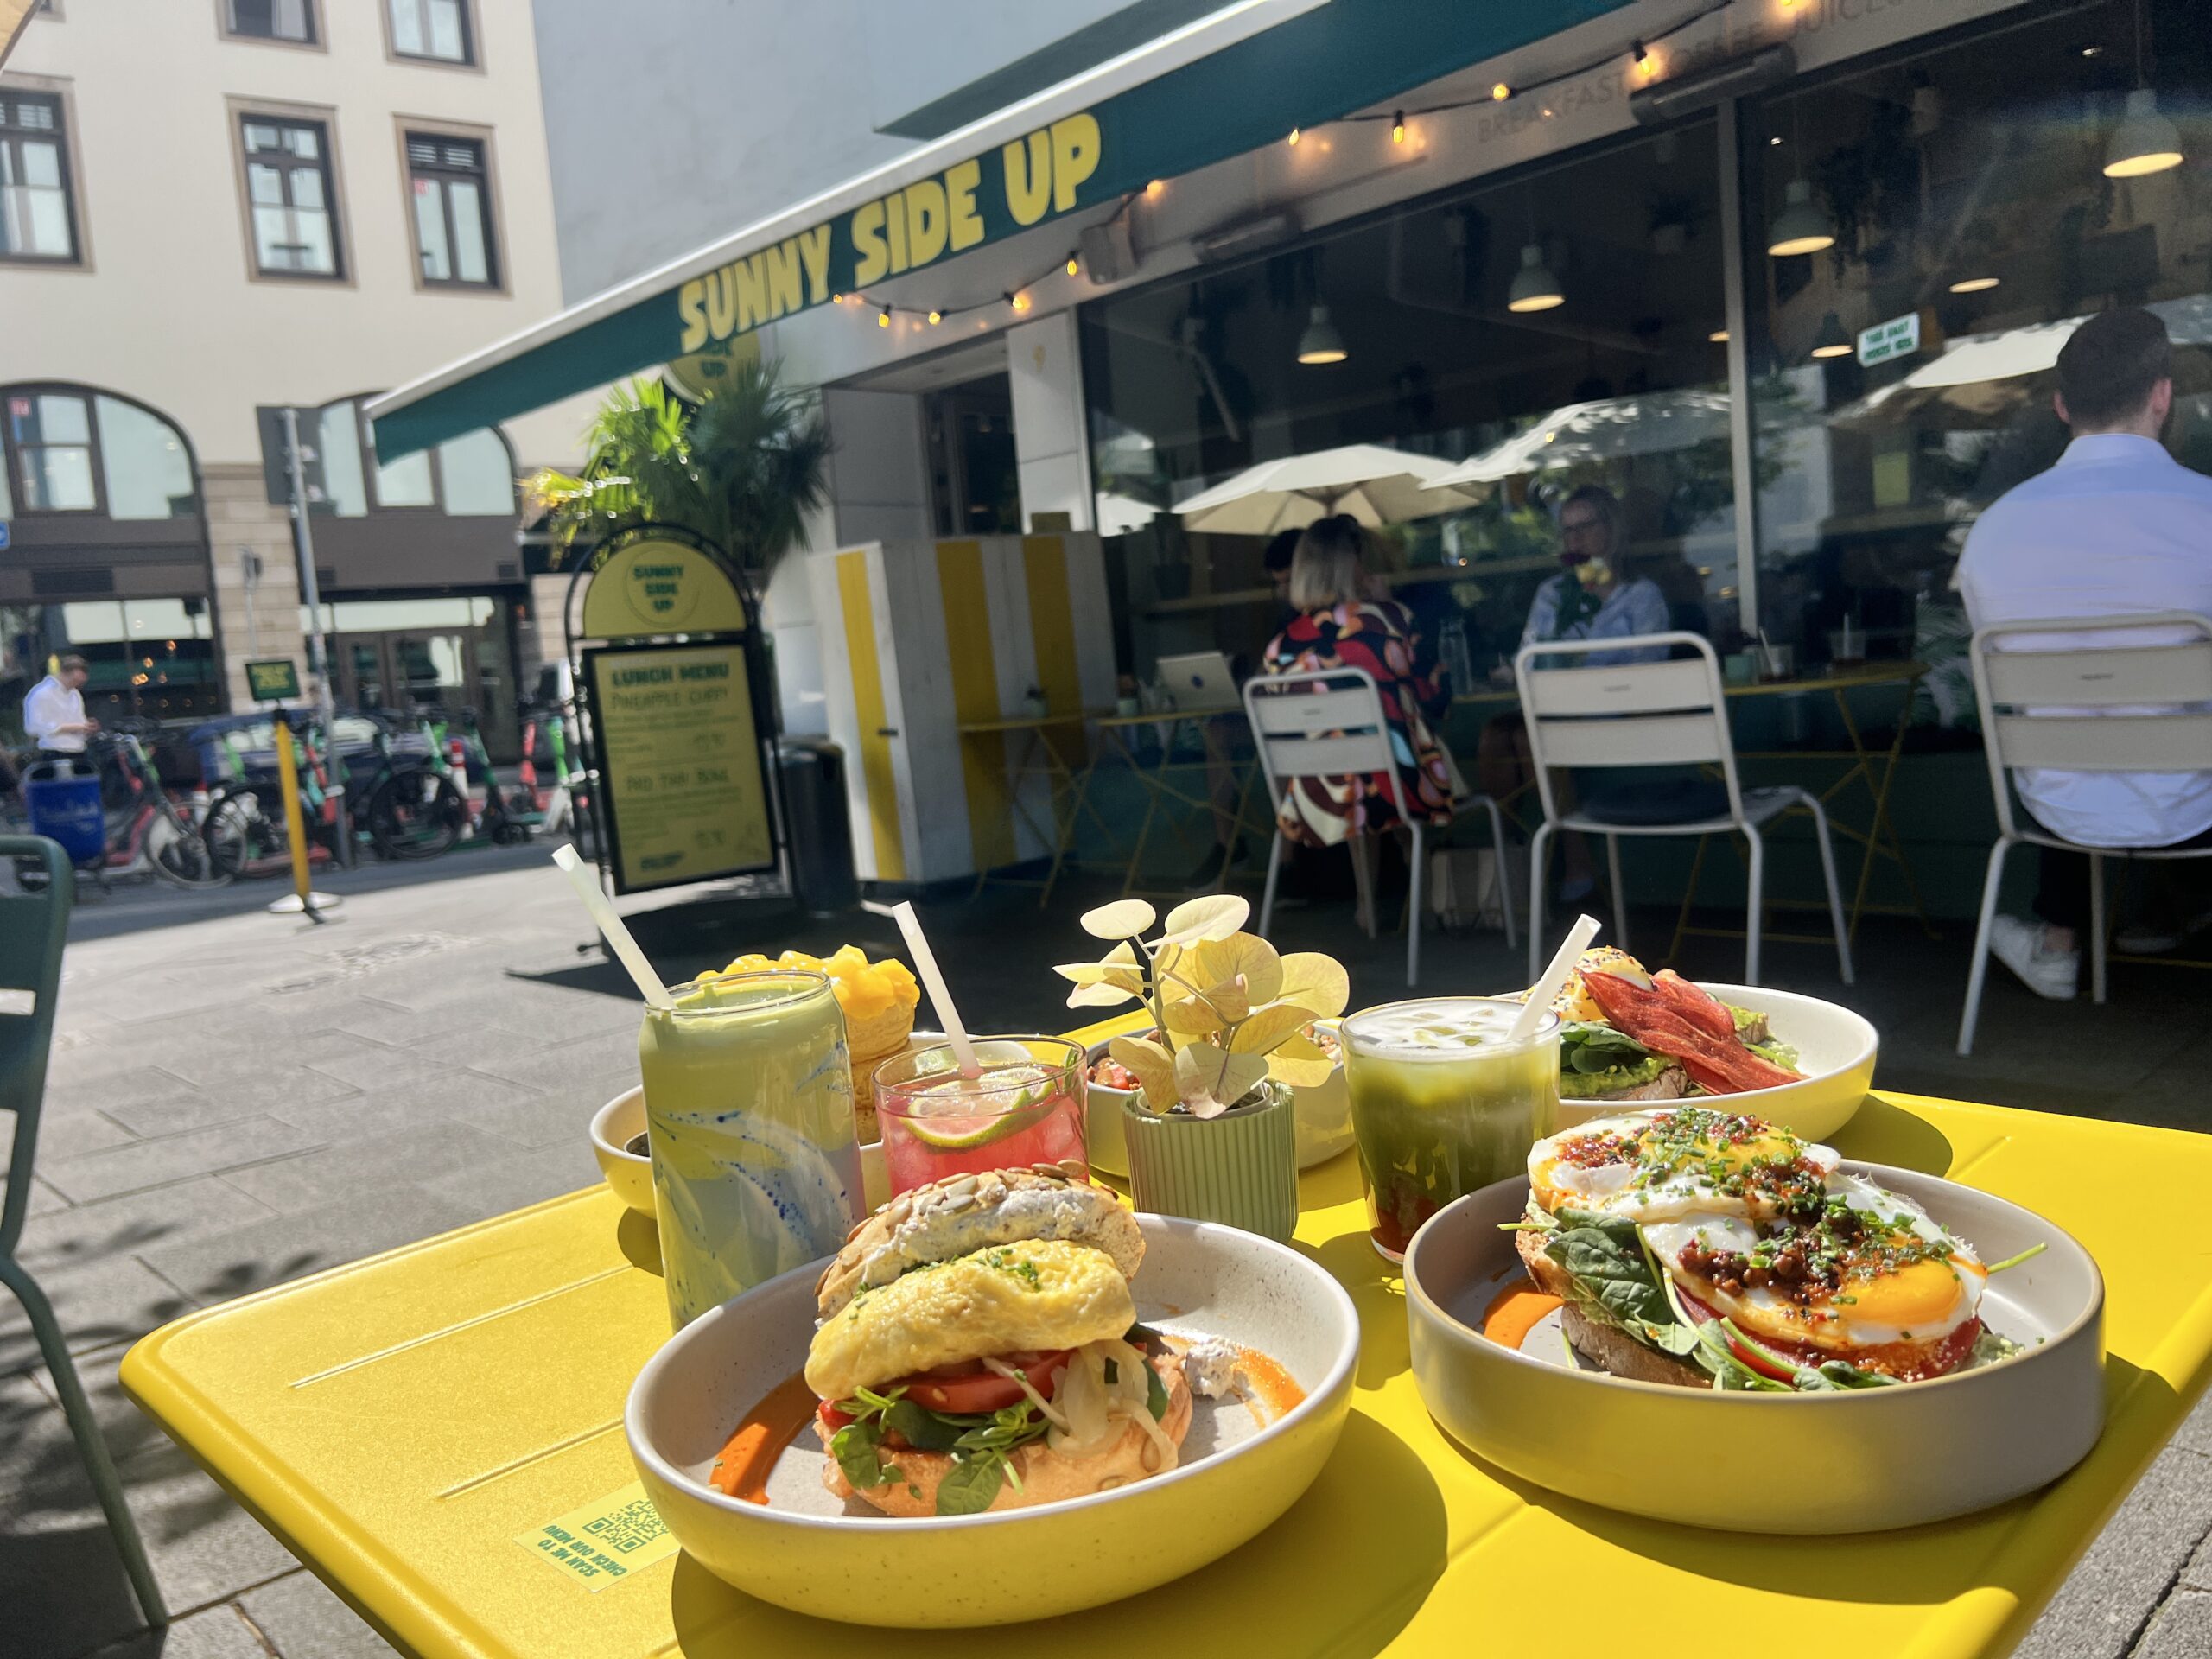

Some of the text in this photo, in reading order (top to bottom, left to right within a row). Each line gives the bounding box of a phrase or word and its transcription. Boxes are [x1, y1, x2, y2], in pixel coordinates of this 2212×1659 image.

[679, 113, 1102, 353] SUNNY SIDE UP
[634, 564, 684, 581] SUNNY
[653, 599, 674, 613] UP
[612, 662, 728, 687] LUNCH MENU
[537, 1539, 601, 1578] SCAN ME TO
[542, 1525, 627, 1576] CHECK OUR MENU
